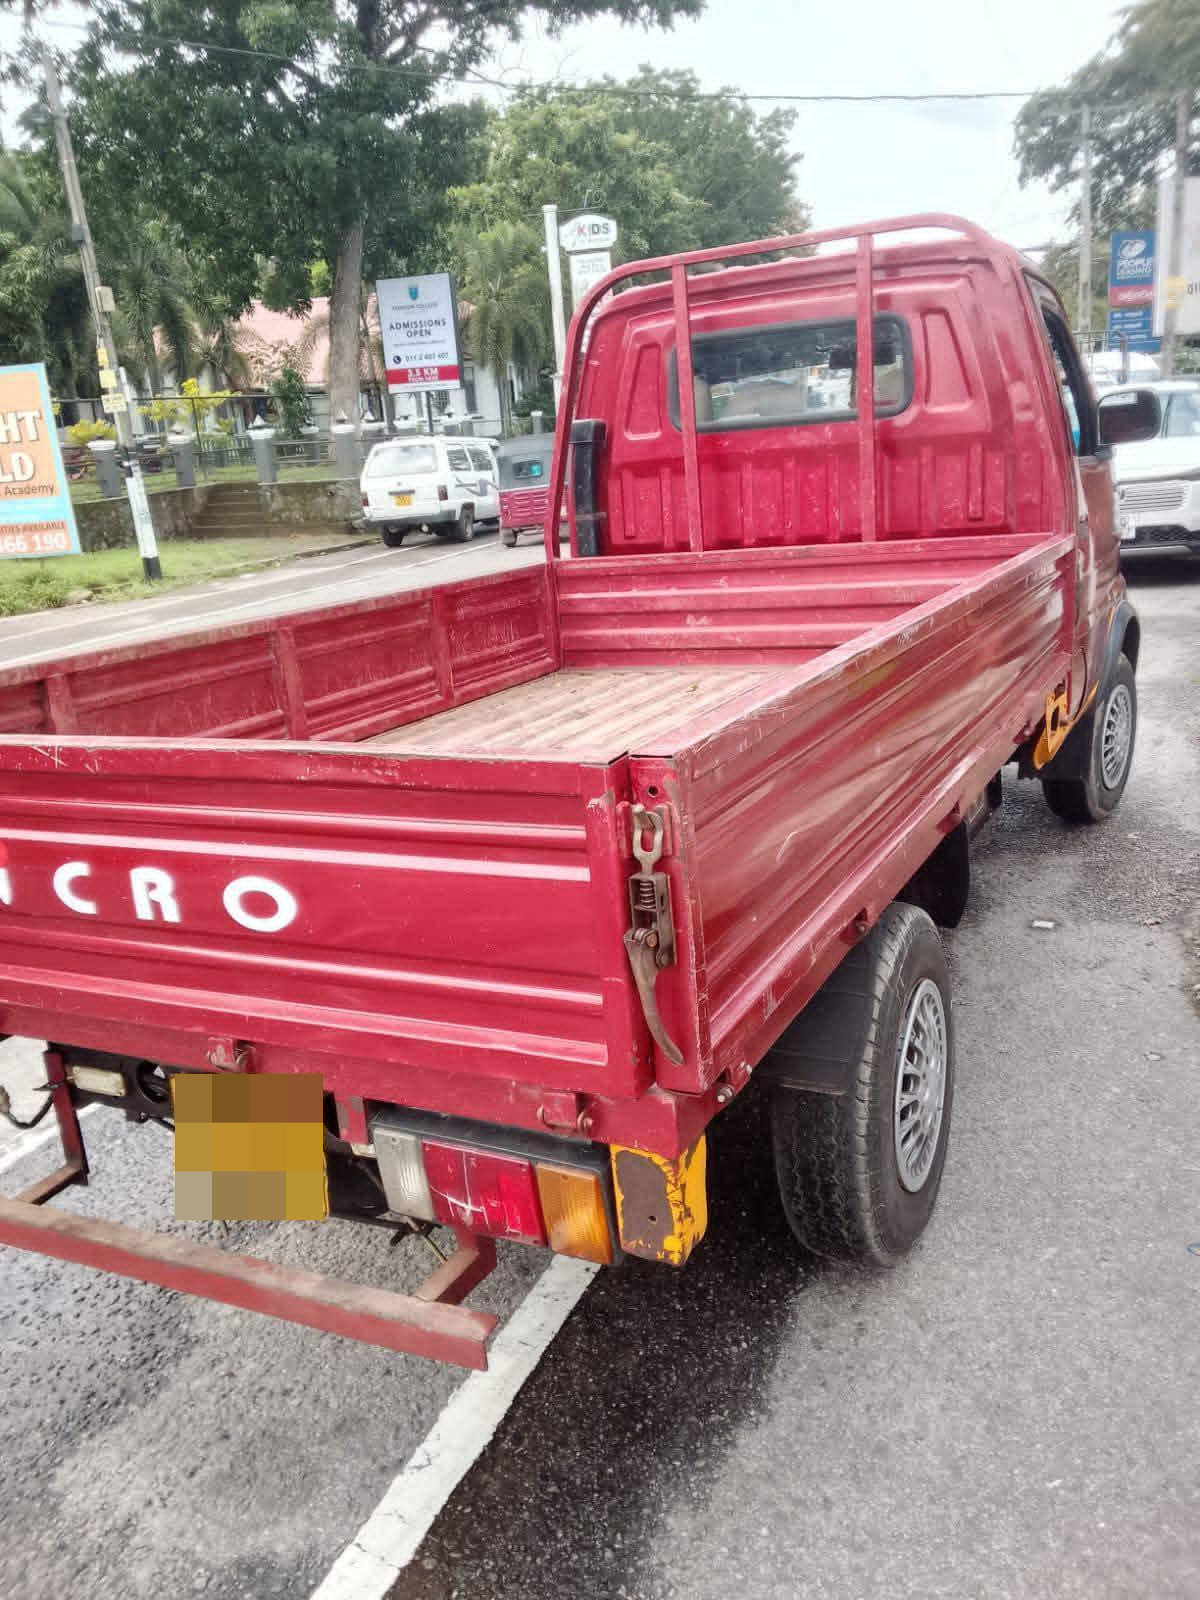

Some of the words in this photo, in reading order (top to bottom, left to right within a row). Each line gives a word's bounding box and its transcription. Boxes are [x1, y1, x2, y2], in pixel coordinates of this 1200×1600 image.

[389, 318, 447, 331] ADMISSIONS
[406, 329, 432, 338] OPEN
[4, 483, 55, 497] Academy
